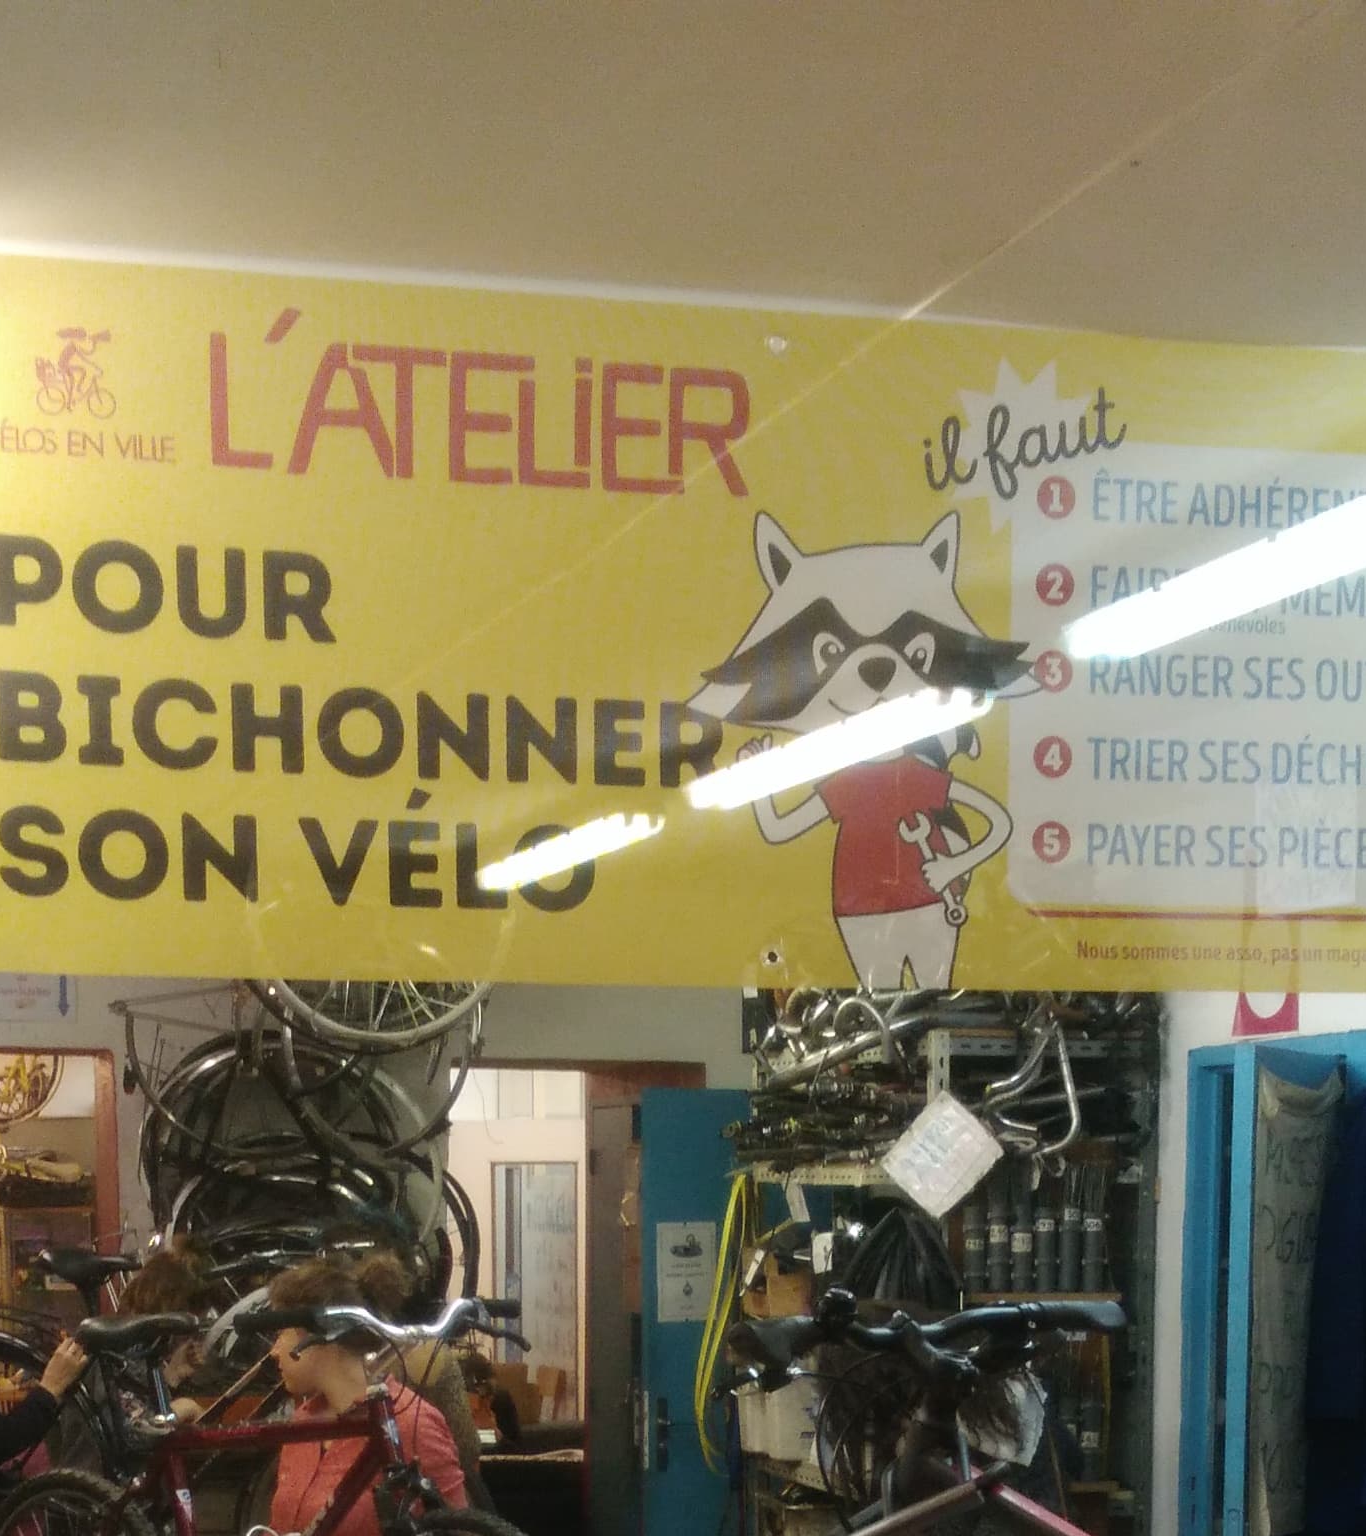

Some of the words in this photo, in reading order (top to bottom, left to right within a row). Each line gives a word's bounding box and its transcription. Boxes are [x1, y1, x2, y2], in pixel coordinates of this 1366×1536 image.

[67, 430, 104, 458] EN
[115, 431, 176, 464] VILLE
[923, 416, 978, 491] il
[983, 386, 1127, 500] faut
[1092, 466, 1179, 525] ÊTRE
[1089, 653, 1234, 699] RANGER
[1243, 657, 1306, 701] SES
[1086, 737, 1190, 783] TRIER
[1199, 739, 1261, 784] SES
[302, 790, 597, 913] VÉLO
[1086, 823, 1196, 868] PAYER
[1205, 826, 1266, 868] SES
[1077, 941, 1118, 960] Nous
[1122, 945, 1190, 962] sommes
[1192, 947, 1222, 961] une
[1225, 947, 1268, 963] asso,
[1271, 947, 1299, 965] pas
[1302, 948, 1323, 961] un
